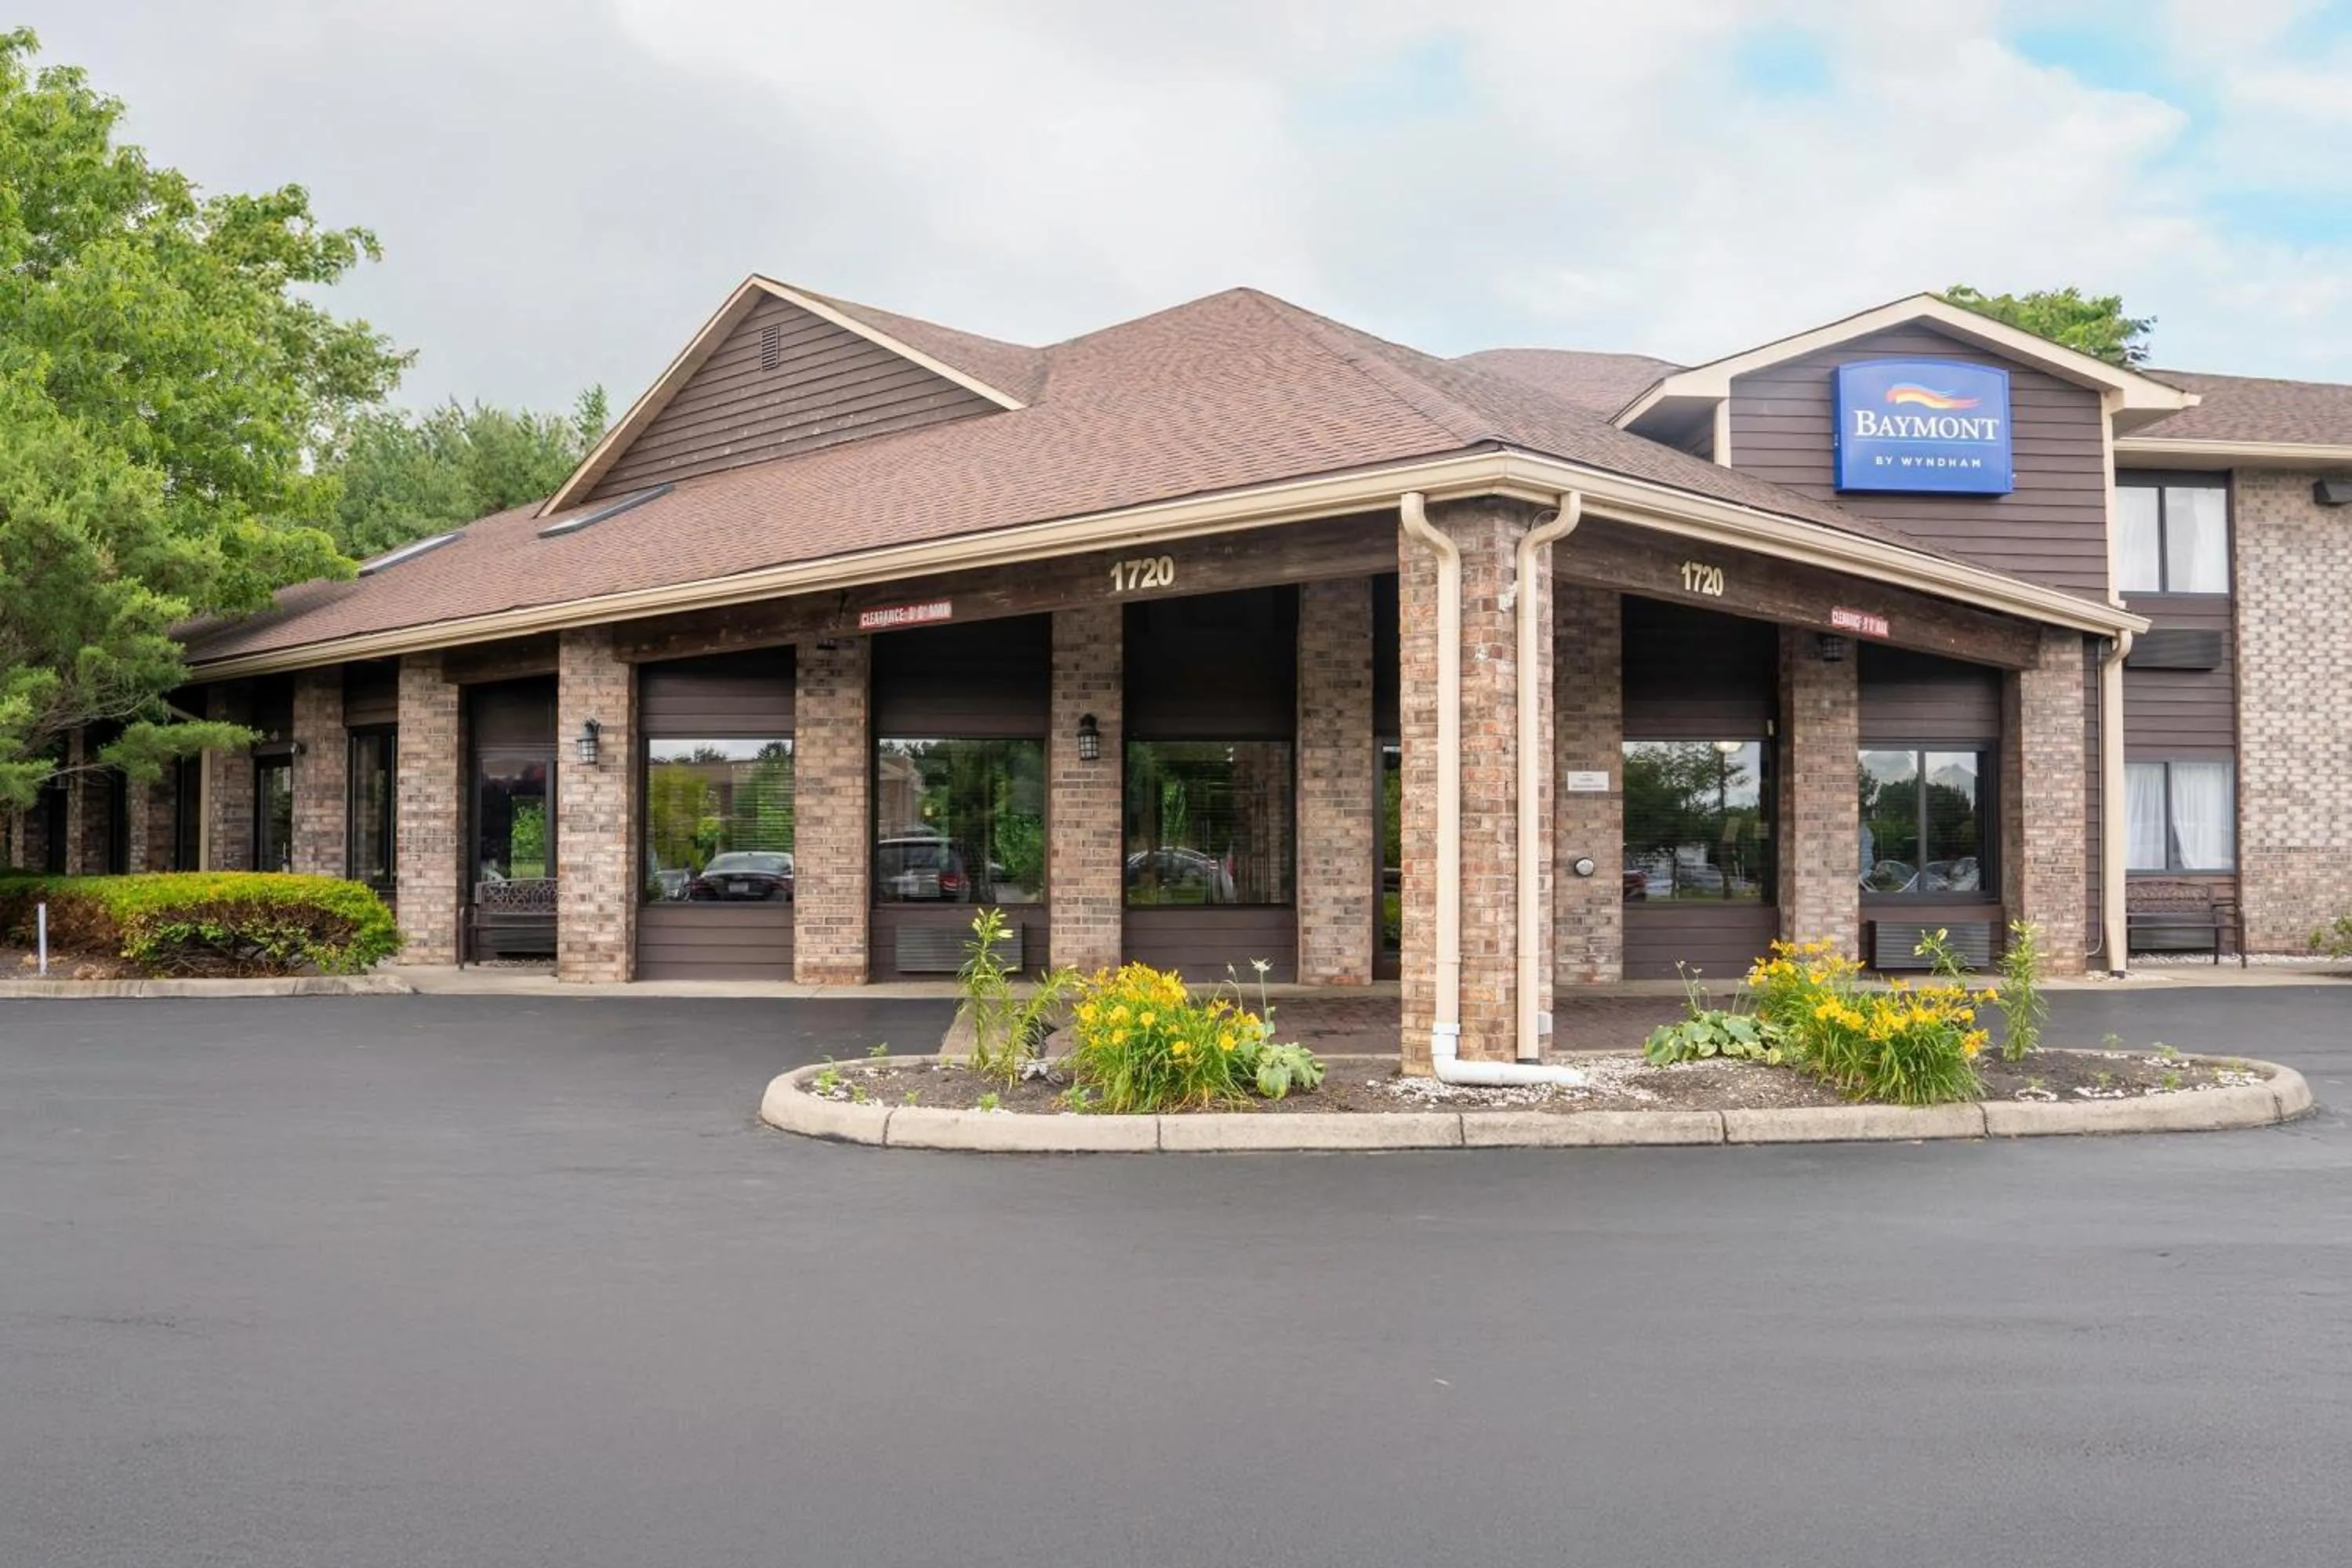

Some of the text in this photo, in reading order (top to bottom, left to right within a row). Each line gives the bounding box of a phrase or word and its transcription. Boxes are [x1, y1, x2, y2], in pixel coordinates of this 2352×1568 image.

[1853, 410, 1999, 440] BAYMONT
[1875, 456, 1981, 468] BY WYNDHAM
[1110, 555, 1174, 592] 1720
[1681, 561, 1724, 597] 1720
